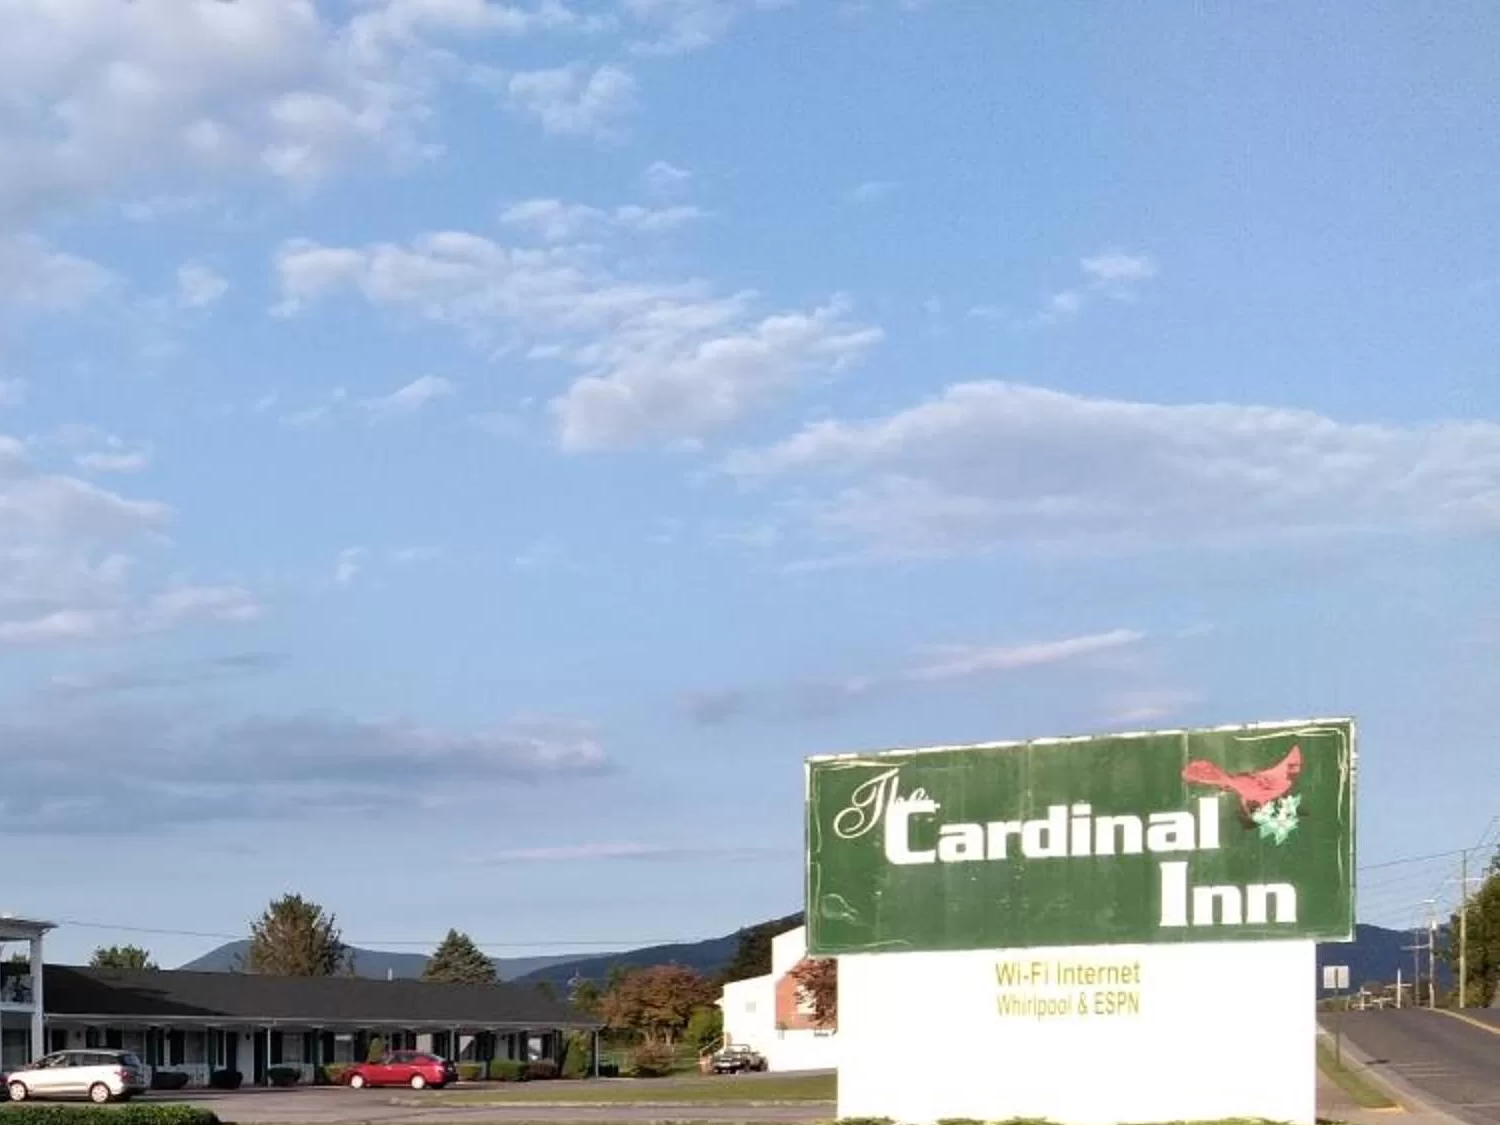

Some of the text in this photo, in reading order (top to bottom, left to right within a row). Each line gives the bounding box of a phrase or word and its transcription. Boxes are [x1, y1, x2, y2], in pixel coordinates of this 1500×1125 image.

[884, 796, 1221, 865] Cardinal
[1159, 861, 1298, 927] Inn
[1056, 960, 1141, 986] Internet
[996, 990, 1140, 1022] Whirlpool & ESPN
